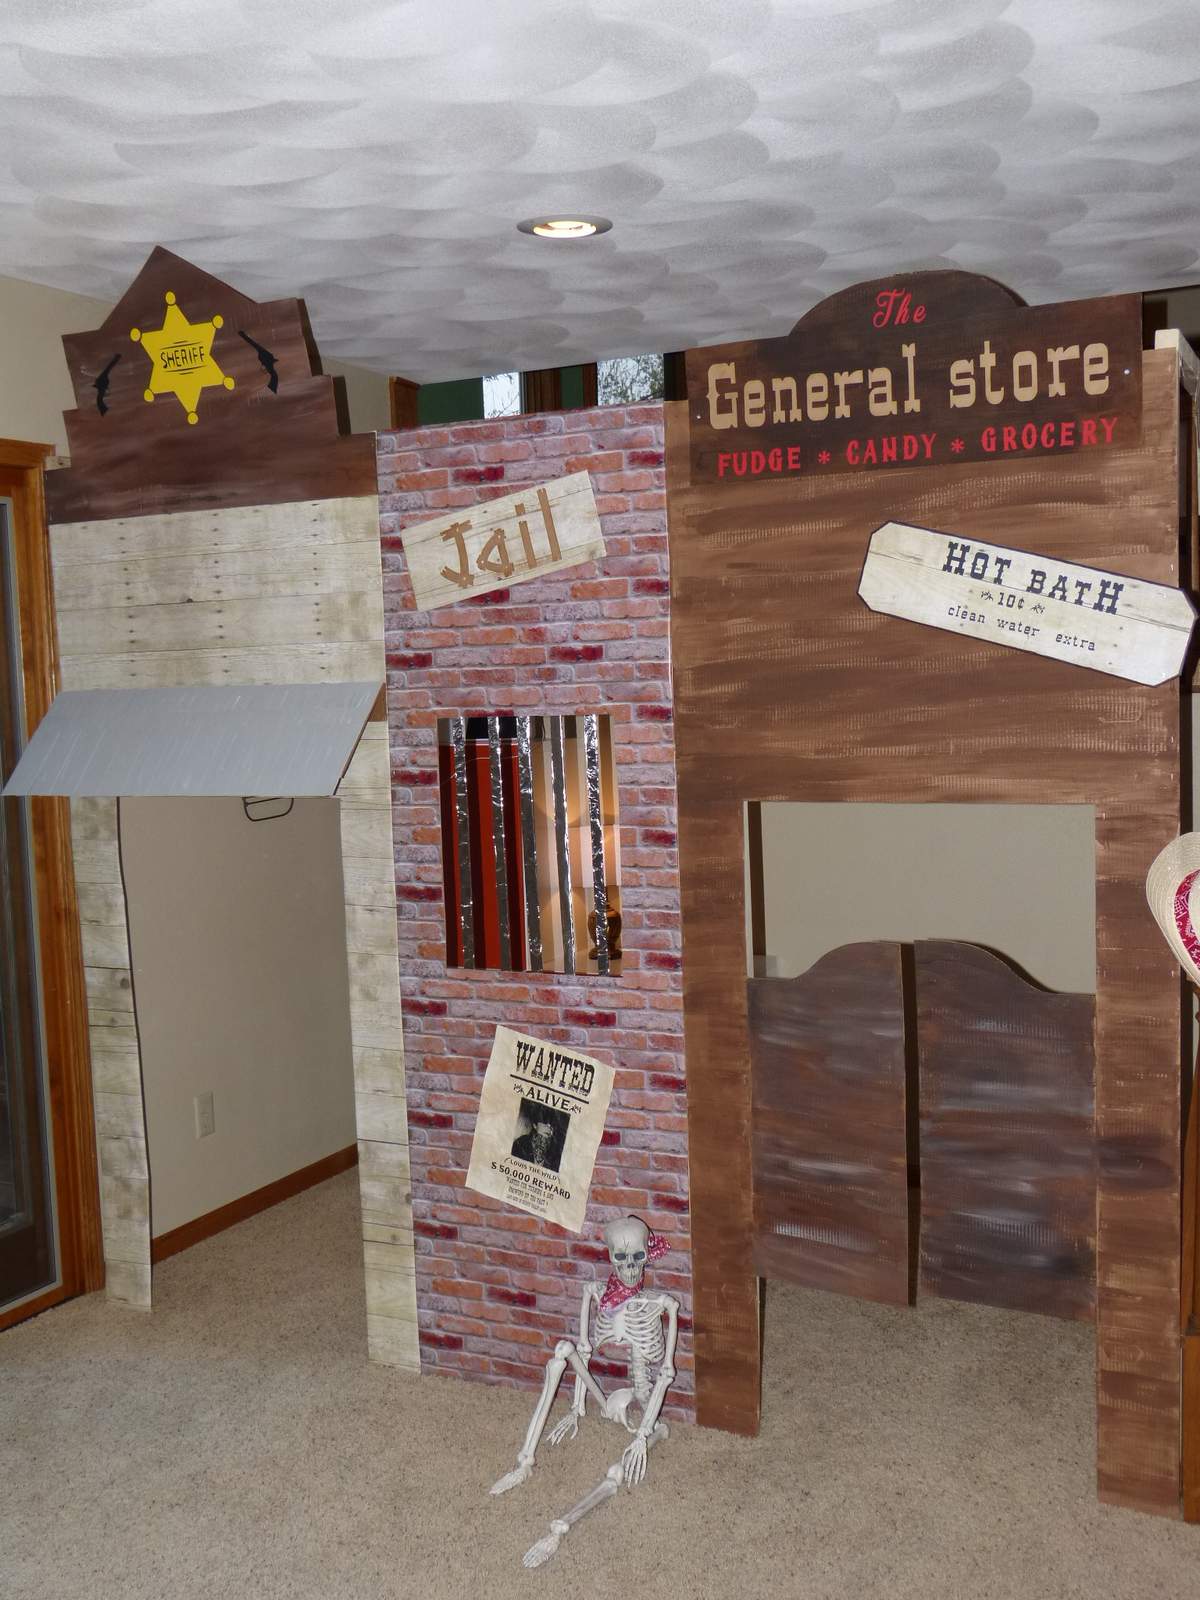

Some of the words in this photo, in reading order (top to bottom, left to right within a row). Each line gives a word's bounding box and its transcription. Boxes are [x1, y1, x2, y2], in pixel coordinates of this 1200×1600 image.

[872, 289, 927, 328] The
[160, 346, 204, 369] SHERIFF
[706, 342, 921, 430] General
[949, 340, 1109, 408] store
[718, 446, 801, 477] FUDGE
[845, 433, 937, 465] CANDY
[981, 417, 1119, 453] GROCERY
[440, 488, 562, 588] Jail
[942, 541, 1012, 585] HOT
[1026, 568, 1124, 615] BATH
[997, 592, 1025, 609] 10¢
[948, 604, 986, 625] clean
[997, 617, 1040, 637] water
[1055, 632, 1096, 651] extra
[516, 1040, 595, 1096] WANTED
[526, 1086, 571, 1110] ALIVE
[532, 1177, 571, 1200] REWARD
